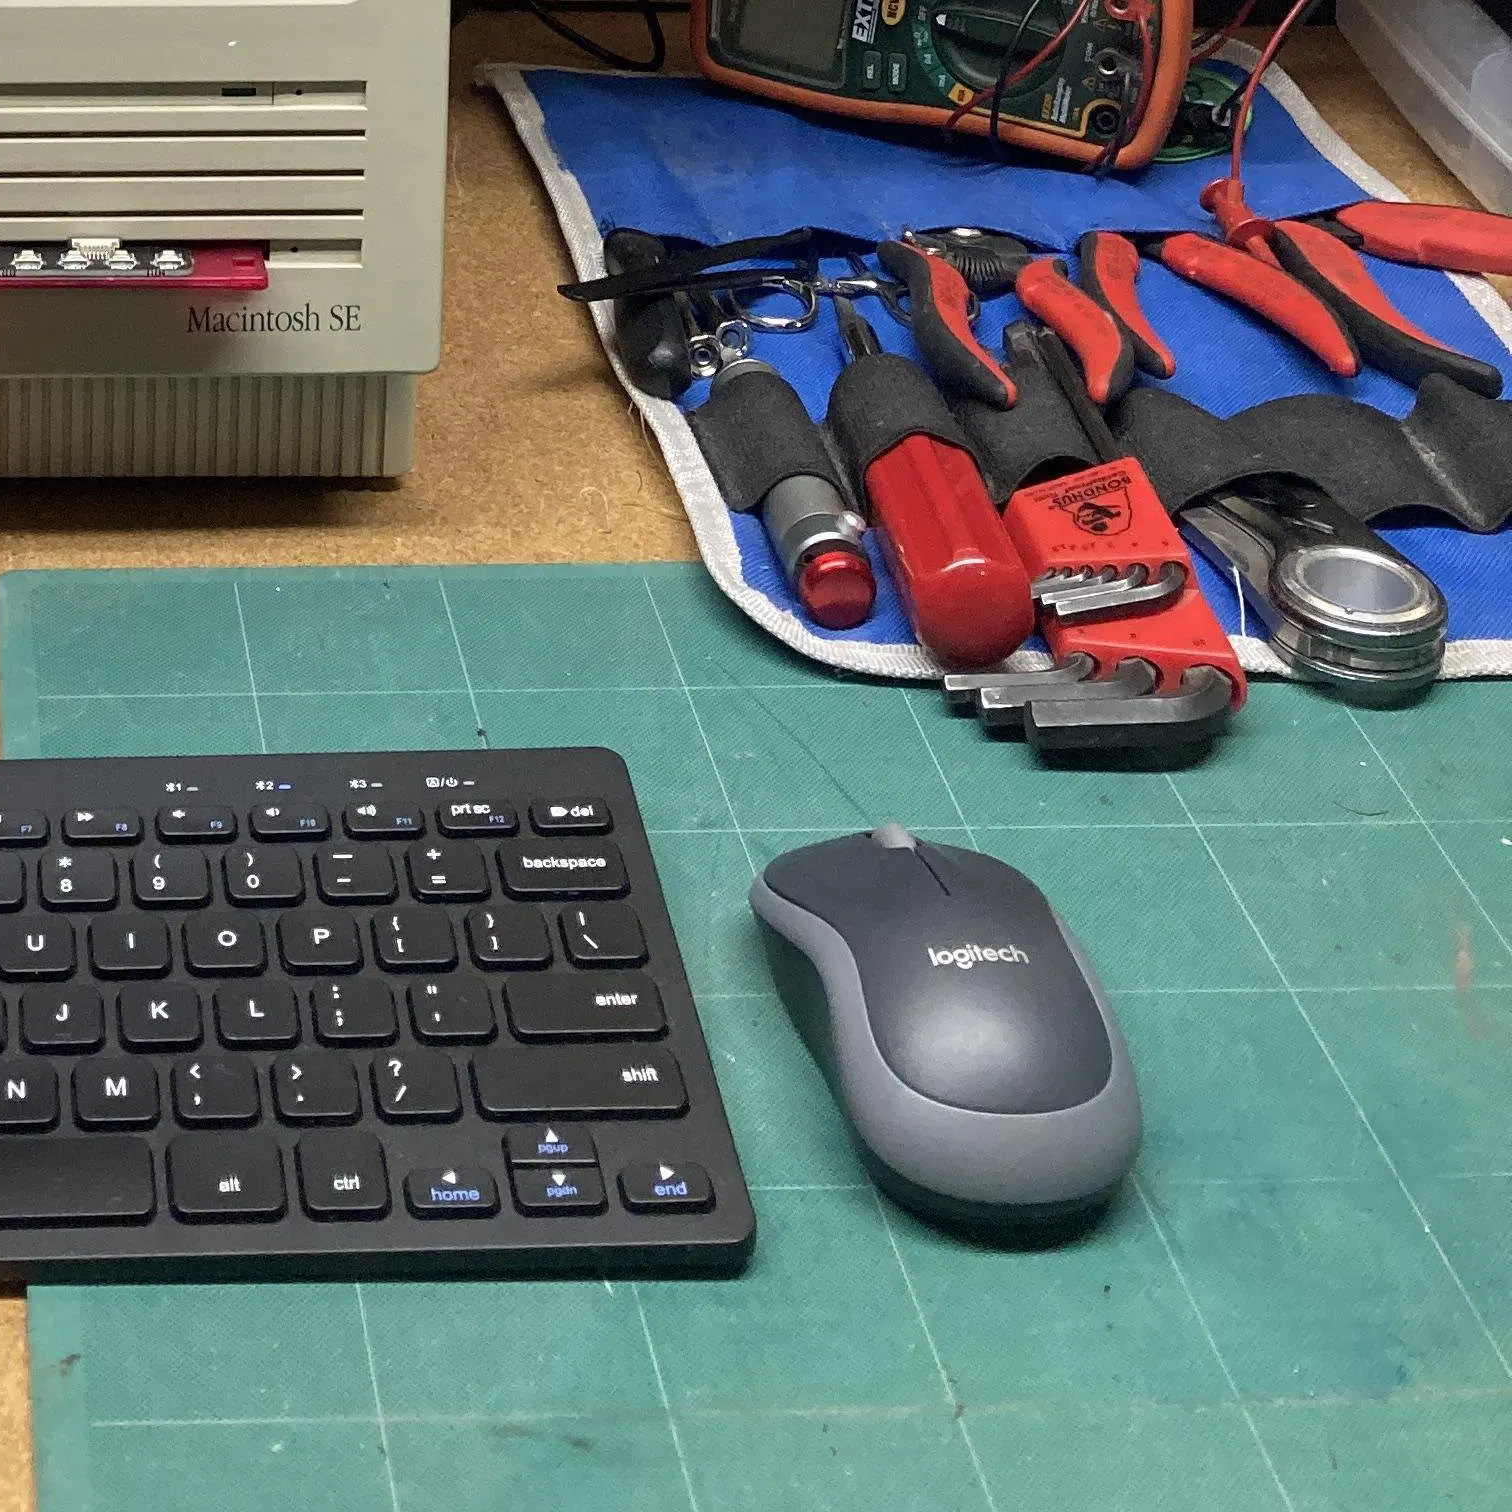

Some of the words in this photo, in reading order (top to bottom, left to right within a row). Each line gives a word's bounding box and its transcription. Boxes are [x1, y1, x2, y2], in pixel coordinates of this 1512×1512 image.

[187, 302, 321, 333] Macintosh
[329, 304, 362, 332] SE
[1052, 477, 1132, 506] BONDHUS
[523, 857, 606, 870] backspace
[927, 943, 1030, 970] logitech
[596, 993, 637, 1006] enter
[56, 1004, 69, 1021] J
[149, 1001, 169, 1019] K
[249, 1000, 264, 1017] L
[622, 1065, 659, 1083] shift
[8, 1080, 26, 1099] N
[106, 1077, 126, 1096] M
[219, 1176, 241, 1192] alt
[334, 1174, 360, 1190] ctrl
[656, 1183, 685, 1196] end
[433, 1190, 479, 1200] home
